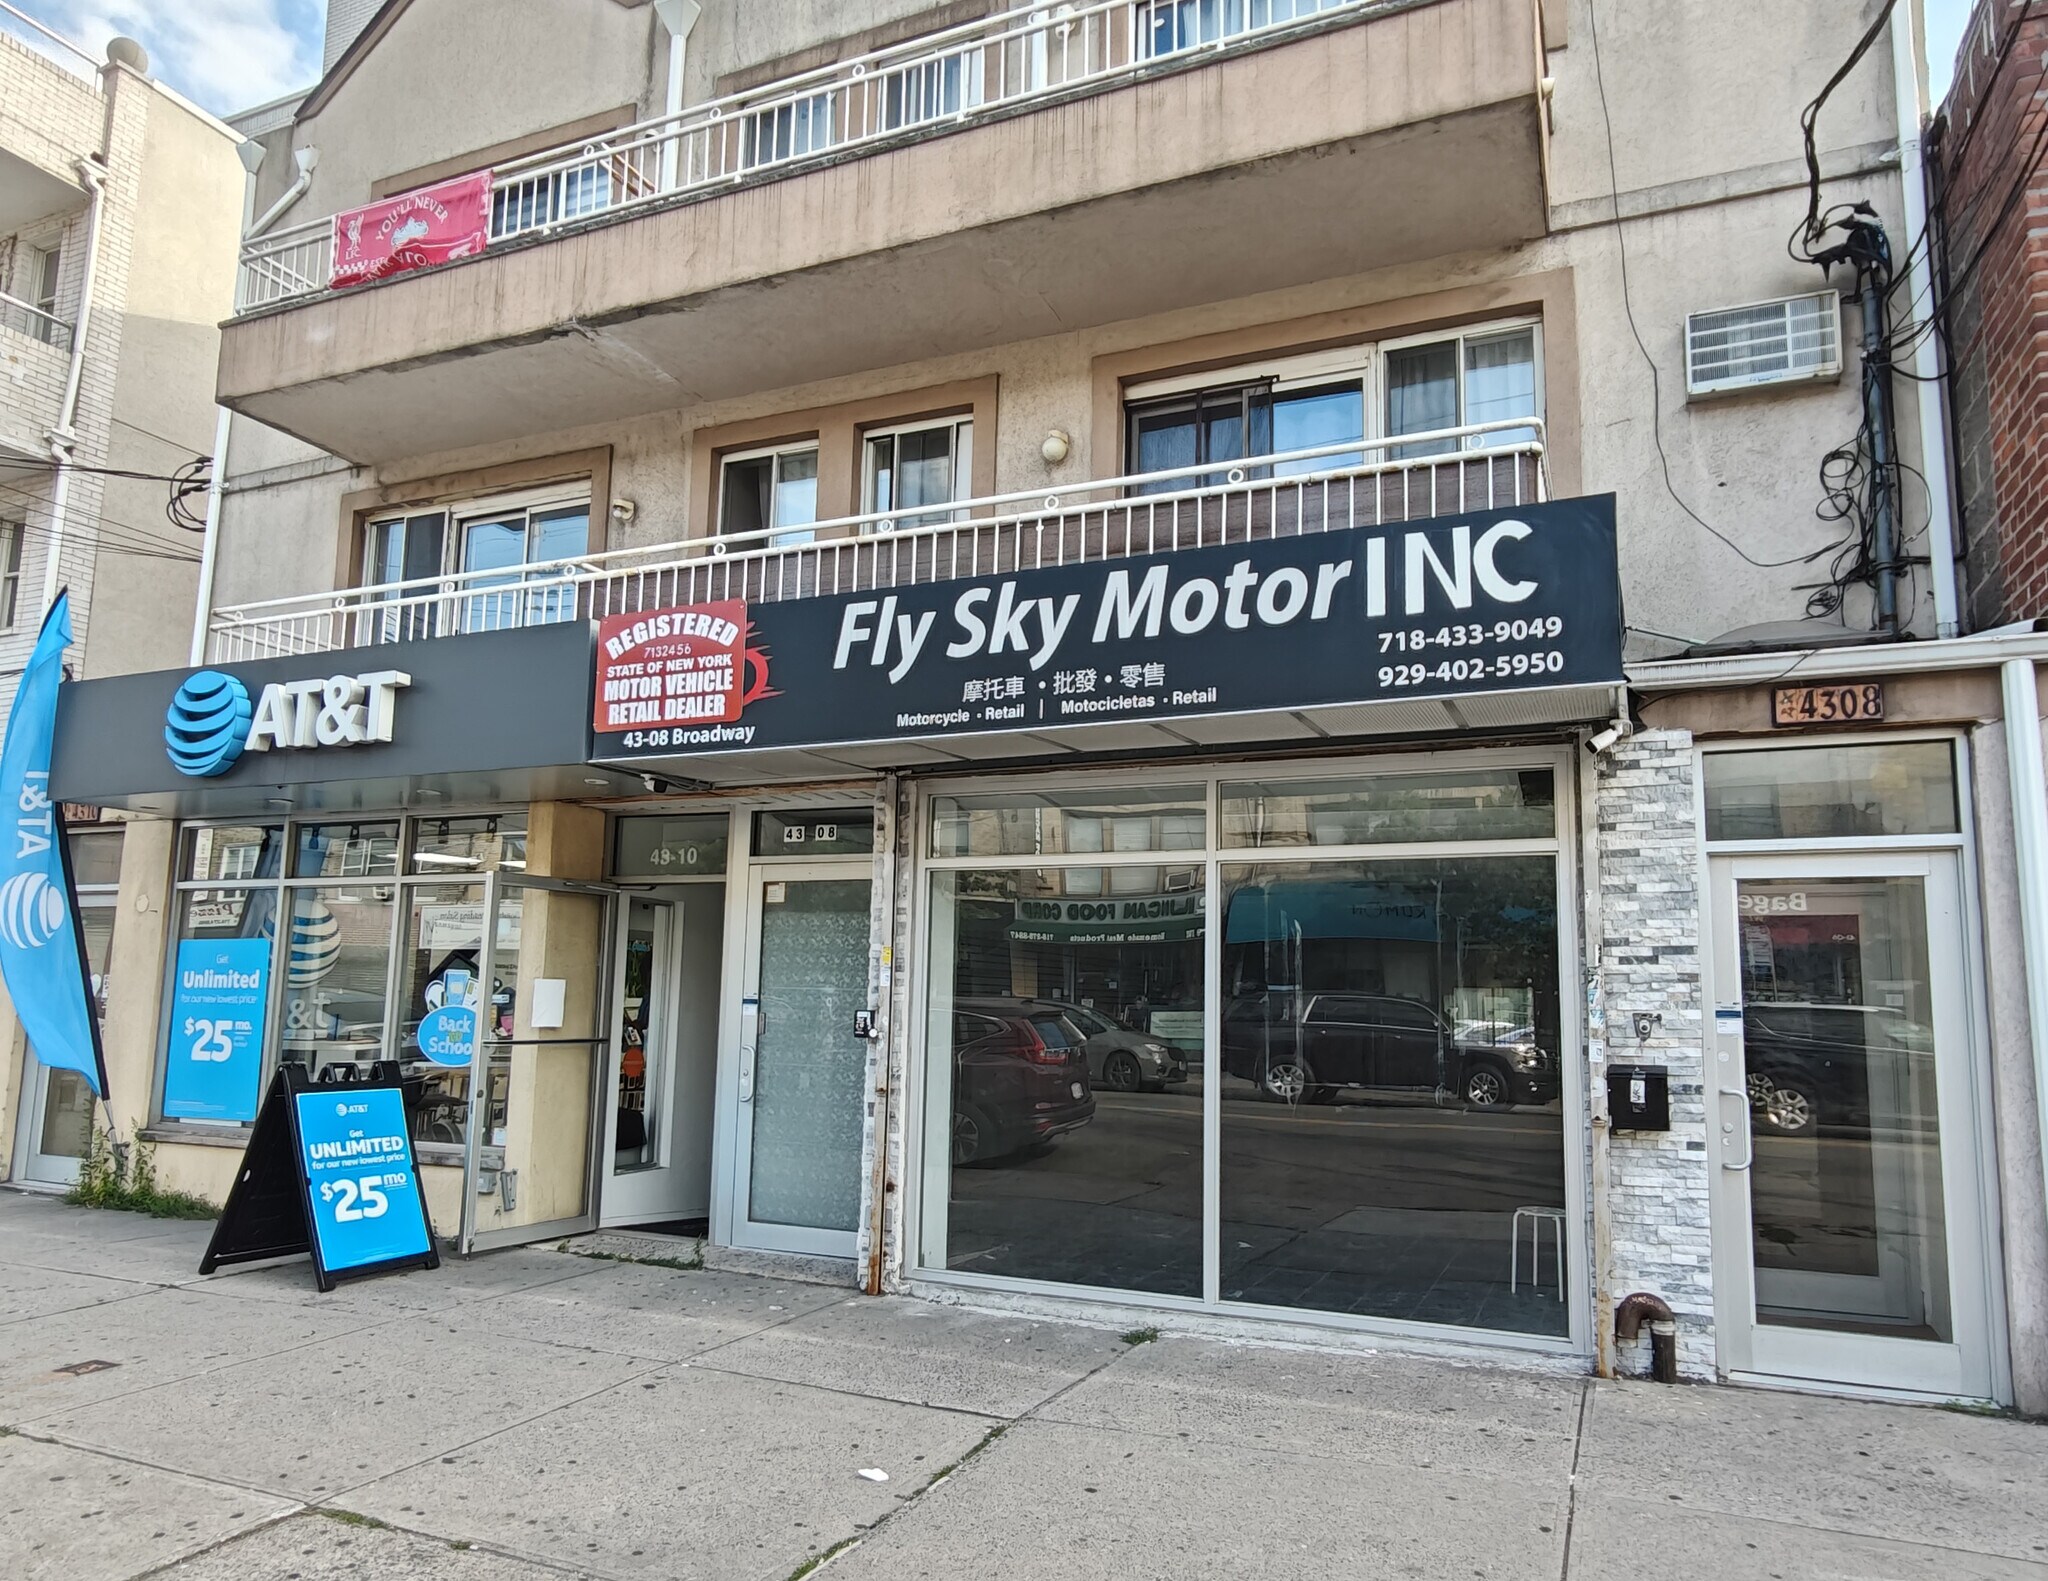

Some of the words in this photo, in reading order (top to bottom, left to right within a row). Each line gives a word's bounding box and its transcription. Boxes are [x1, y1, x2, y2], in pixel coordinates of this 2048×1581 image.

[375, 200, 413, 241] YOU'LL
[414, 197, 449, 224] NEVER
[833, 595, 936, 684] Fly
[946, 580, 1080, 671] Sky
[1091, 558, 1353, 643] Motor
[1366, 519, 1540, 617] INC
[604, 612, 740, 661] REGISTERED
[1378, 616, 1564, 654] 718-433-9049
[643, 642, 692, 659] 7132456
[607, 662, 644, 678] STATE
[647, 660, 663, 674] OF
[666, 657, 694, 672] NEW
[697, 653, 733, 669] YORK
[1378, 650, 1564, 688] 929-402-5950
[604, 675, 662, 702] MOTOR
[665, 668, 734, 696] VEHICLE
[962, 676, 1025, 703] 摩托車
[1053, 668, 1098, 696] 批發
[1119, 662, 1166, 690] 零售
[244, 669, 412, 752] AT&T
[608, 700, 662, 725] RETAIL
[664, 693, 726, 721] DEALER
[897, 709, 970, 727] Motorcycle
[985, 704, 1025, 720] Retail
[1061, 694, 1156, 715] Motocicletas
[1172, 687, 1217, 706] Retail
[1799, 685, 1882, 720] 4308
[623, 728, 669, 748] 43-08
[672, 724, 756, 746] Broadway
[785, 828, 804, 841] 43
[817, 825, 836, 839] 08
[216, 954, 230, 965] Get
[183, 969, 261, 990] Unlimited
[238, 995, 257, 1006] price
[438, 1014, 473, 1034] Back
[184, 1016, 234, 1063] $25
[428, 1037, 473, 1056] Schoo
[348, 1104, 368, 1114] AT&T
[309, 1136, 404, 1159] UNLIMITED
[349, 1129, 364, 1138] Get
[312, 1160, 326, 1170] for
[326, 1159, 341, 1169] our
[341, 1157, 358, 1167] new
[359, 1154, 385, 1165] lowest
[386, 1152, 406, 1164] price
[320, 1175, 389, 1223] $25
[383, 1172, 407, 1185] mo
